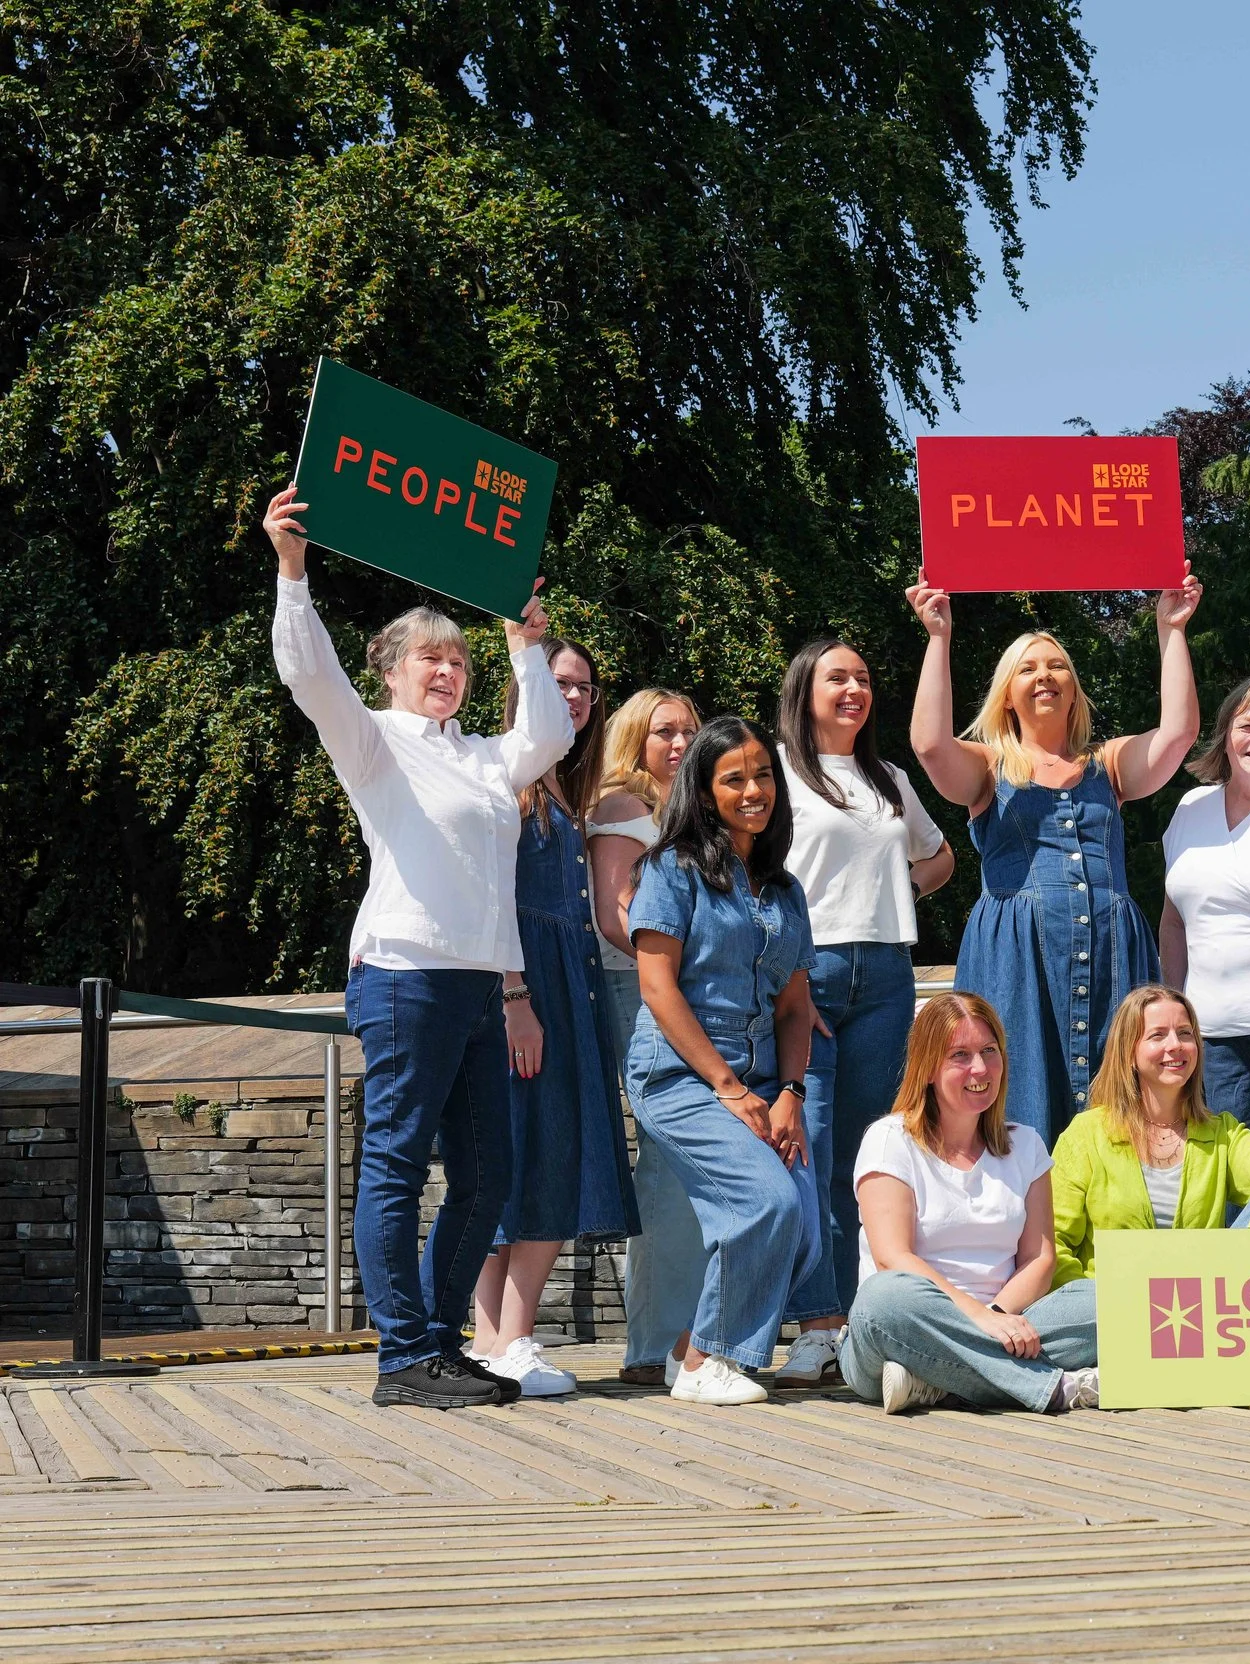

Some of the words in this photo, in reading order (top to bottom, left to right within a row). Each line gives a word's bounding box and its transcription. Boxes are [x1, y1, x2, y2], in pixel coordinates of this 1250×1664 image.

[493, 467, 528, 493] LODE
[1112, 463, 1150, 476] LODE
[1112, 475, 1148, 488] STAR
[334, 436, 521, 547] PEOPLE
[490, 480, 523, 504] STAR
[951, 494, 1153, 528] PLANET
